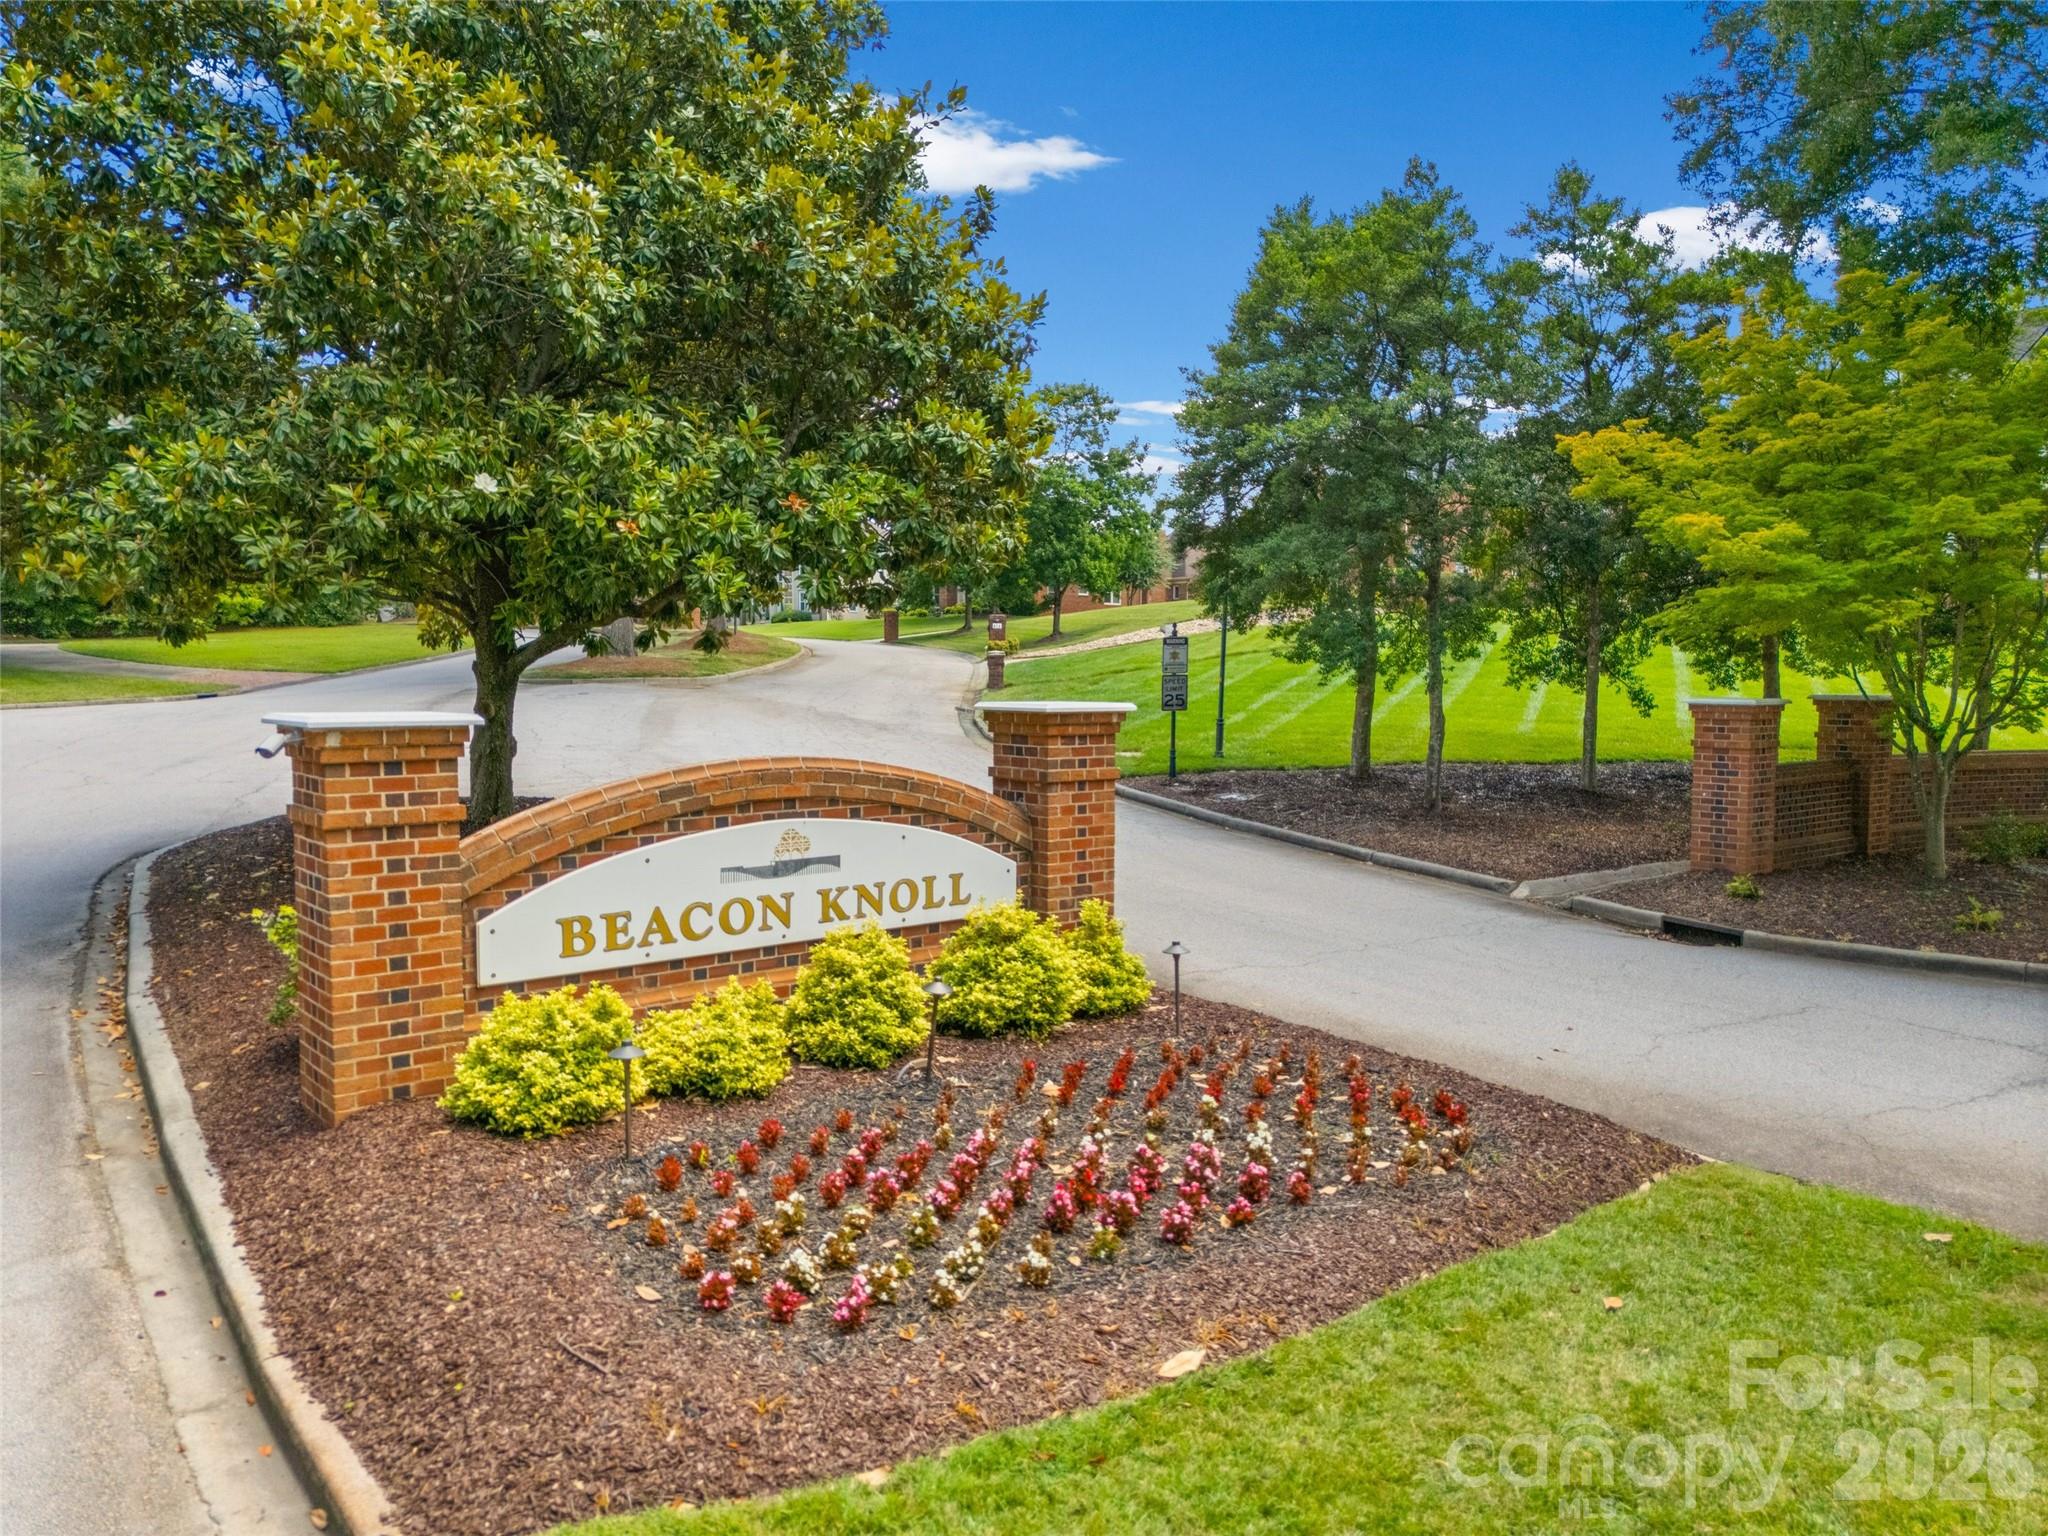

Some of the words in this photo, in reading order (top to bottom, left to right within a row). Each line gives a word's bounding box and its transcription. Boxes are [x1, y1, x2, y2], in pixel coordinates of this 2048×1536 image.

[1164, 694, 1185, 707] 25
[556, 892, 794, 959] BEACON
[817, 872, 972, 924] KNOLL
